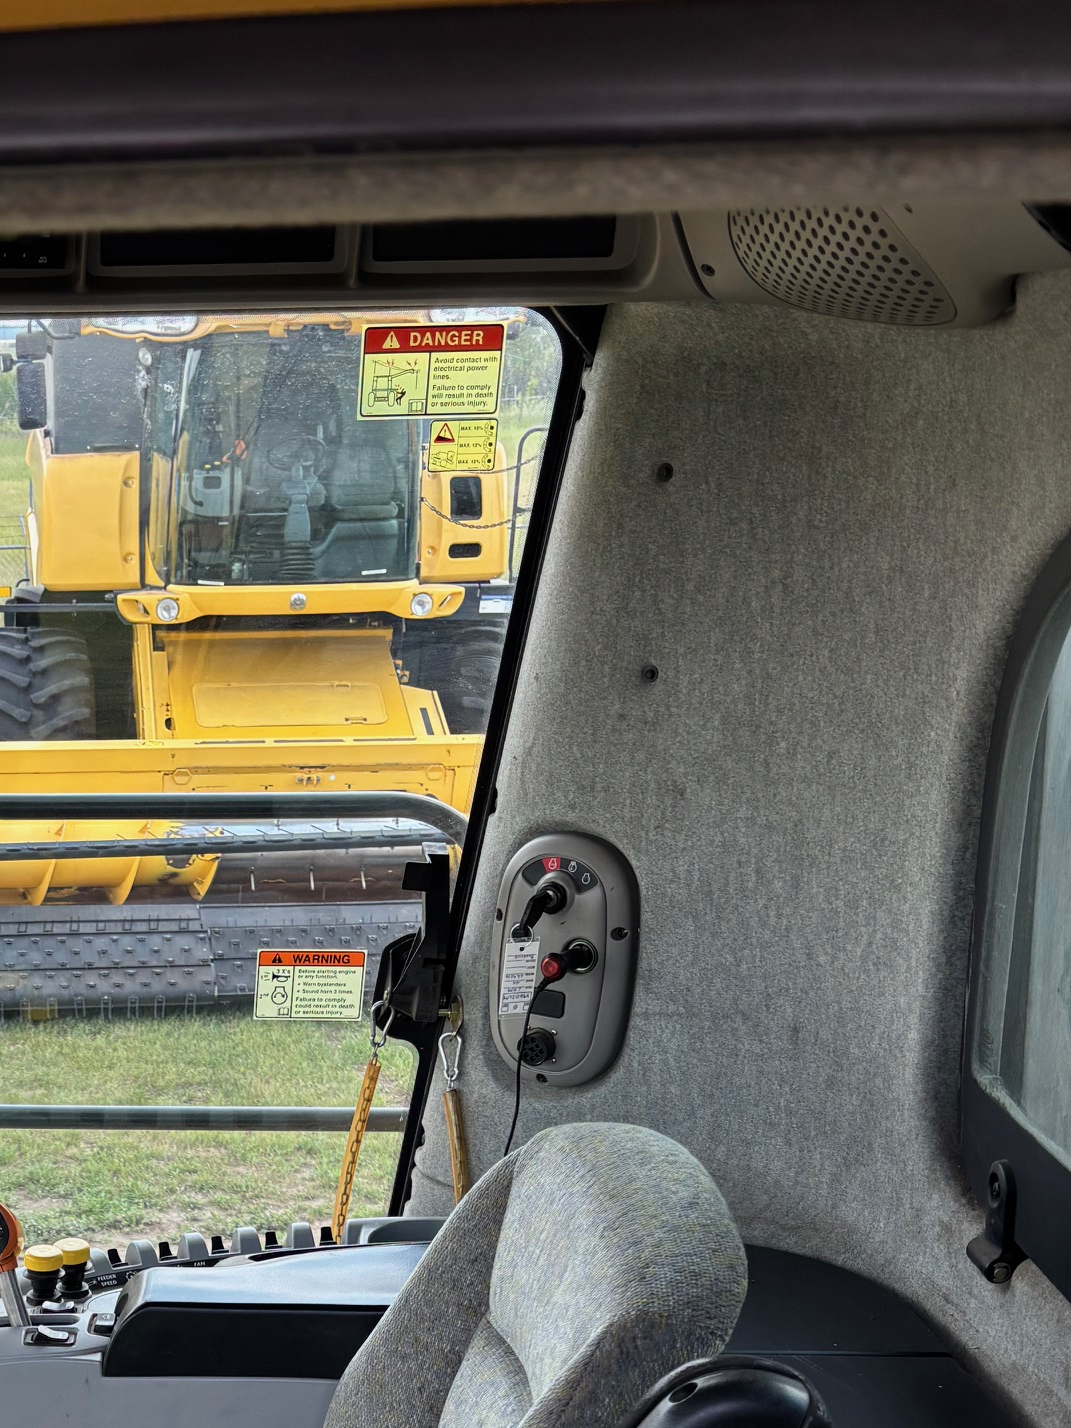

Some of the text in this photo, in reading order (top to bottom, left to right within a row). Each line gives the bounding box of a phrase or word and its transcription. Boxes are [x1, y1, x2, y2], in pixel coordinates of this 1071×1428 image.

[410, 331, 484, 347] DANGER
[466, 384, 491, 392] comply
[467, 400, 488, 408] injury.
[292, 954, 351, 964] WARNING
[97, 1273, 117, 1282] FEEDER
[100, 1279, 118, 1287] SPEED
